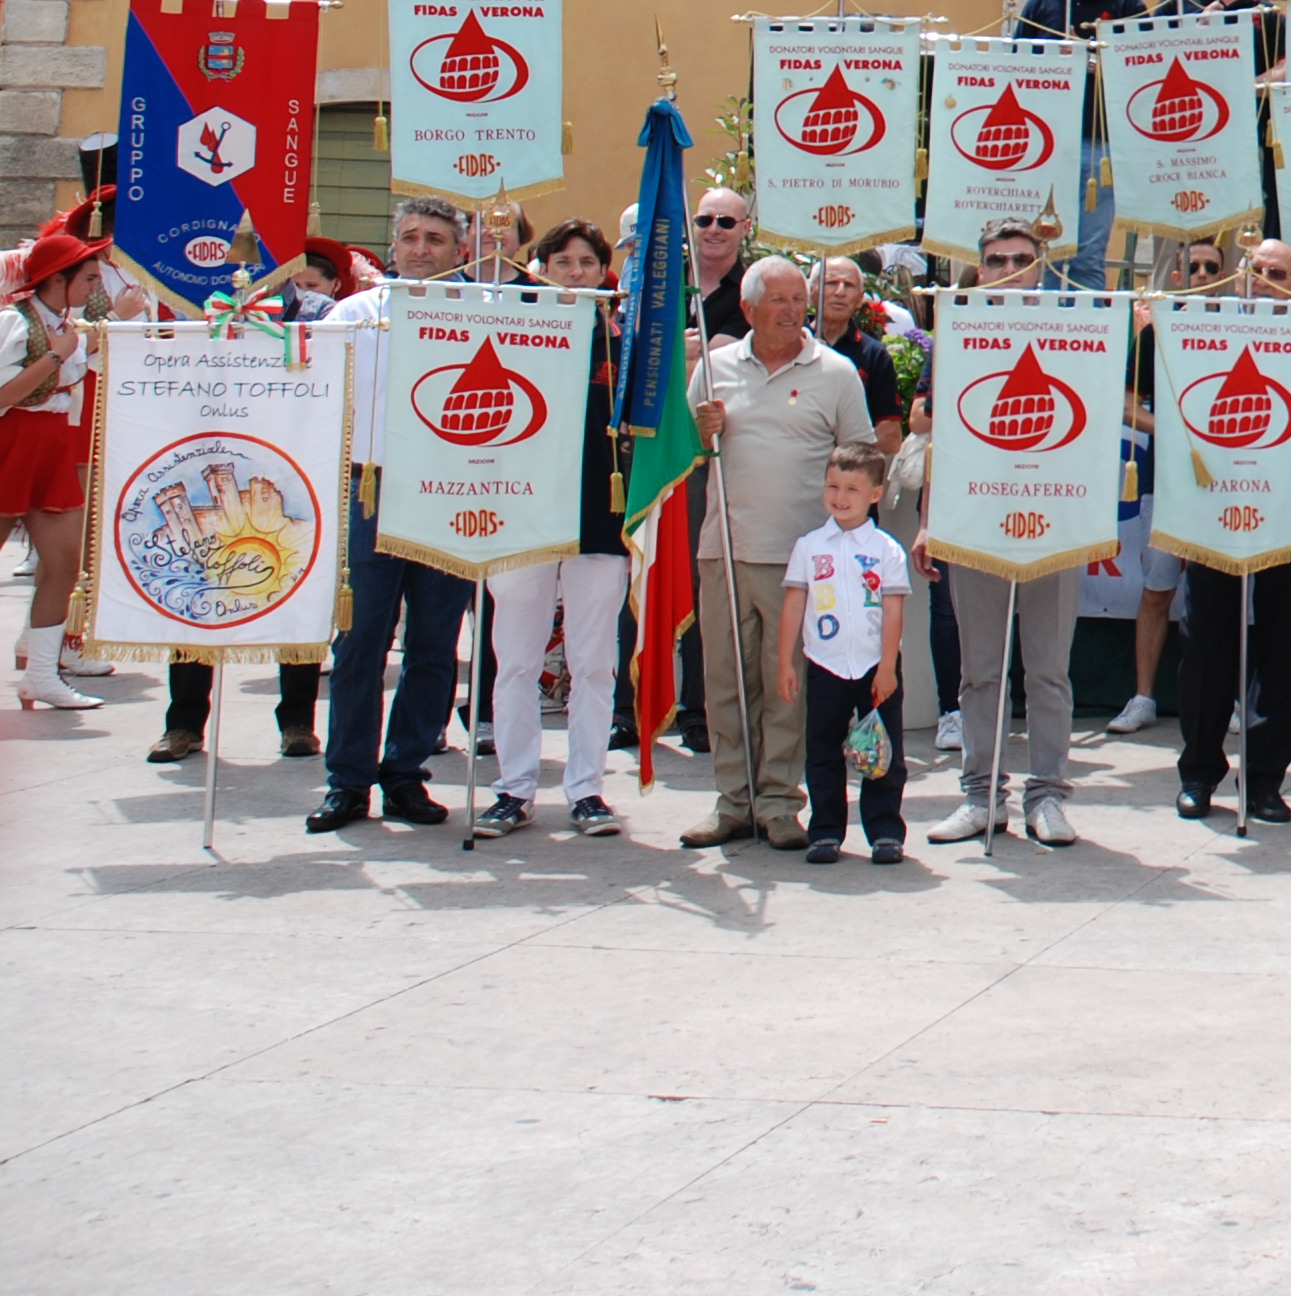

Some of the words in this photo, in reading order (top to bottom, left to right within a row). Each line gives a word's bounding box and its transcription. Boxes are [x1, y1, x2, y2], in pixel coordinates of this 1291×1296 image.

[414, 5, 458, 17] FIDAS
[480, 7, 544, 17] VERONA
[415, 129, 465, 141] BORGO
[475, 129, 535, 141] TRENTO
[128, 97, 146, 201] GRUPPO
[283, 100, 300, 203] SANGUE
[1171, 156, 1217, 167] MASSIMO
[768, 179, 778, 188] S.
[783, 179, 824, 188] PIETRO
[832, 179, 842, 187] DI
[848, 179, 900, 188] MORUBIO
[1149, 172, 1181, 183] CROCE
[1187, 170, 1226, 181] BIANCA
[967, 187, 1039, 198] ROVERCHIARA
[652, 218, 669, 307] VALEGGIANI
[407, 310, 463, 322] DONATORI
[466, 314, 525, 327] VOLONTARI
[529, 319, 573, 330] SANGUE
[419, 327, 470, 343] FIDAS
[497, 332, 570, 349] VERONA
[963, 337, 1012, 350] FIDAS
[1037, 338, 1106, 352] VERONA
[1182, 338, 1228, 351] FIDAS
[144, 354, 190, 373] Opera
[644, 322, 663, 407] PENSIONATI
[118, 381, 227, 397] STEFANO
[234, 382, 329, 398] TOFFOLI
[200, 404, 248, 417] Onlus
[420, 480, 533, 495] MAZZANTICA
[968, 482, 1086, 497] ROSEGAFERRO
[1210, 478, 1271, 493] PARONA
